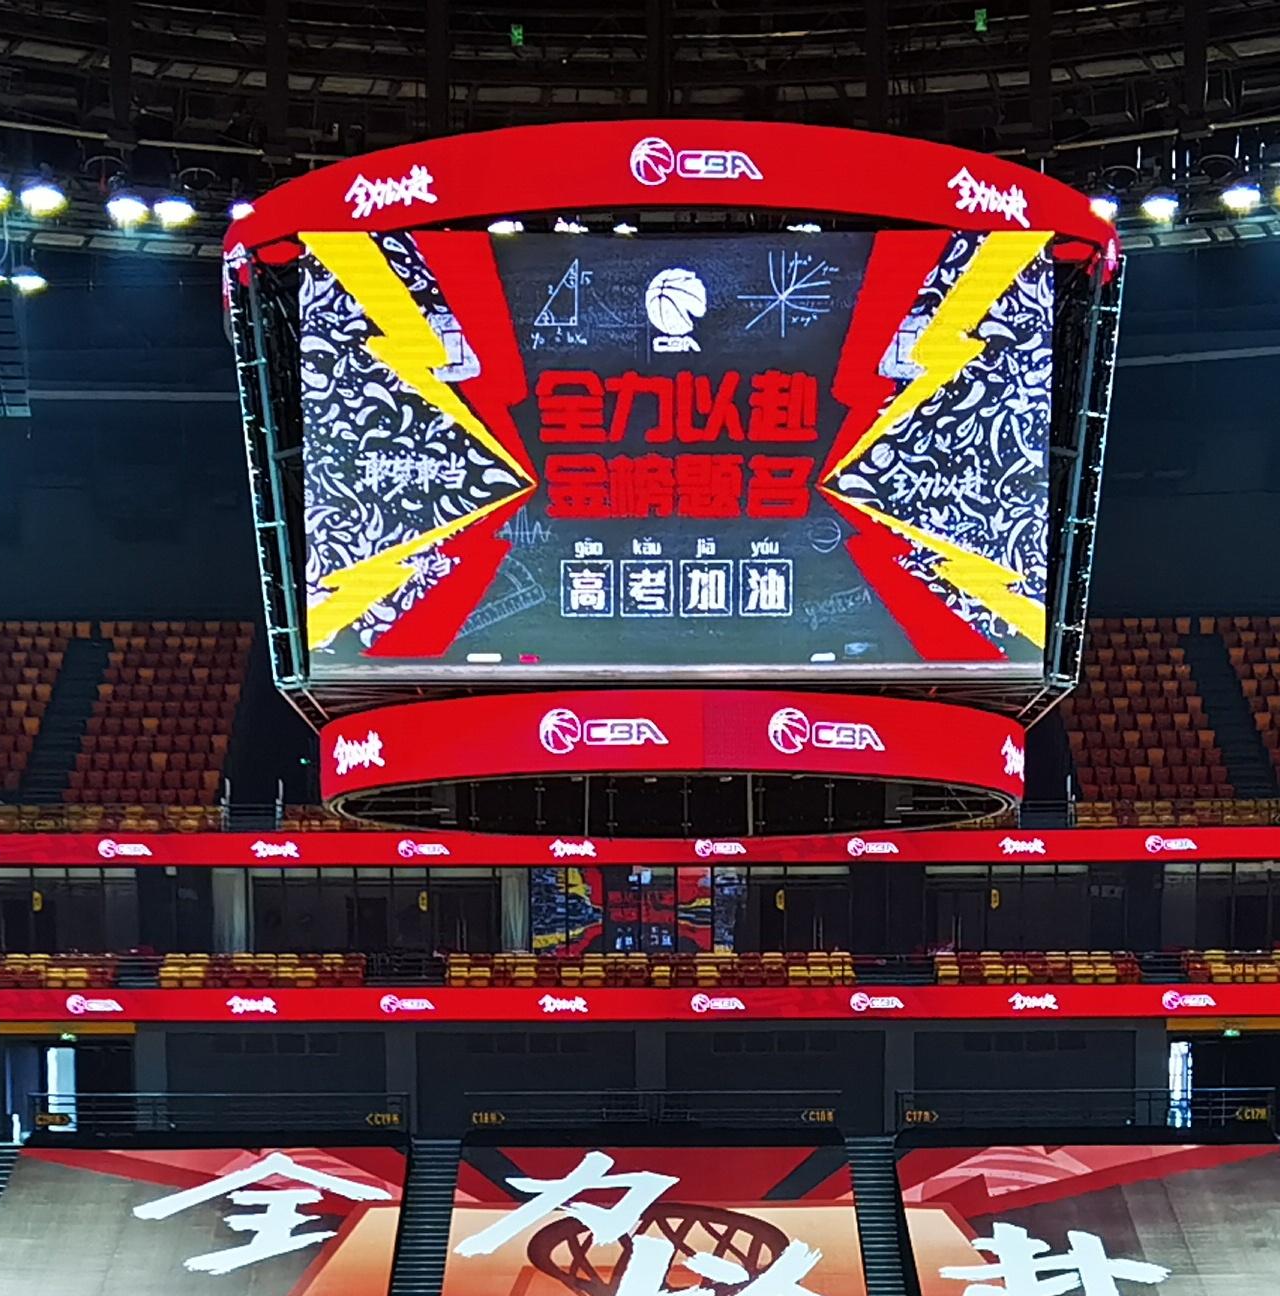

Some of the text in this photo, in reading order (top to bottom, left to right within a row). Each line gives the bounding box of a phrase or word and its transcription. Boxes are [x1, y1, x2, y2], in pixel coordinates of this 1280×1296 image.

[676, 150, 763, 180] CBA
[535, 370, 818, 443] 全力以赴
[544, 453, 817, 519] 金榜题名
[569, 567, 785, 611] 高考加油
[582, 717, 670, 746] CBA
[811, 723, 885, 751] CBA
